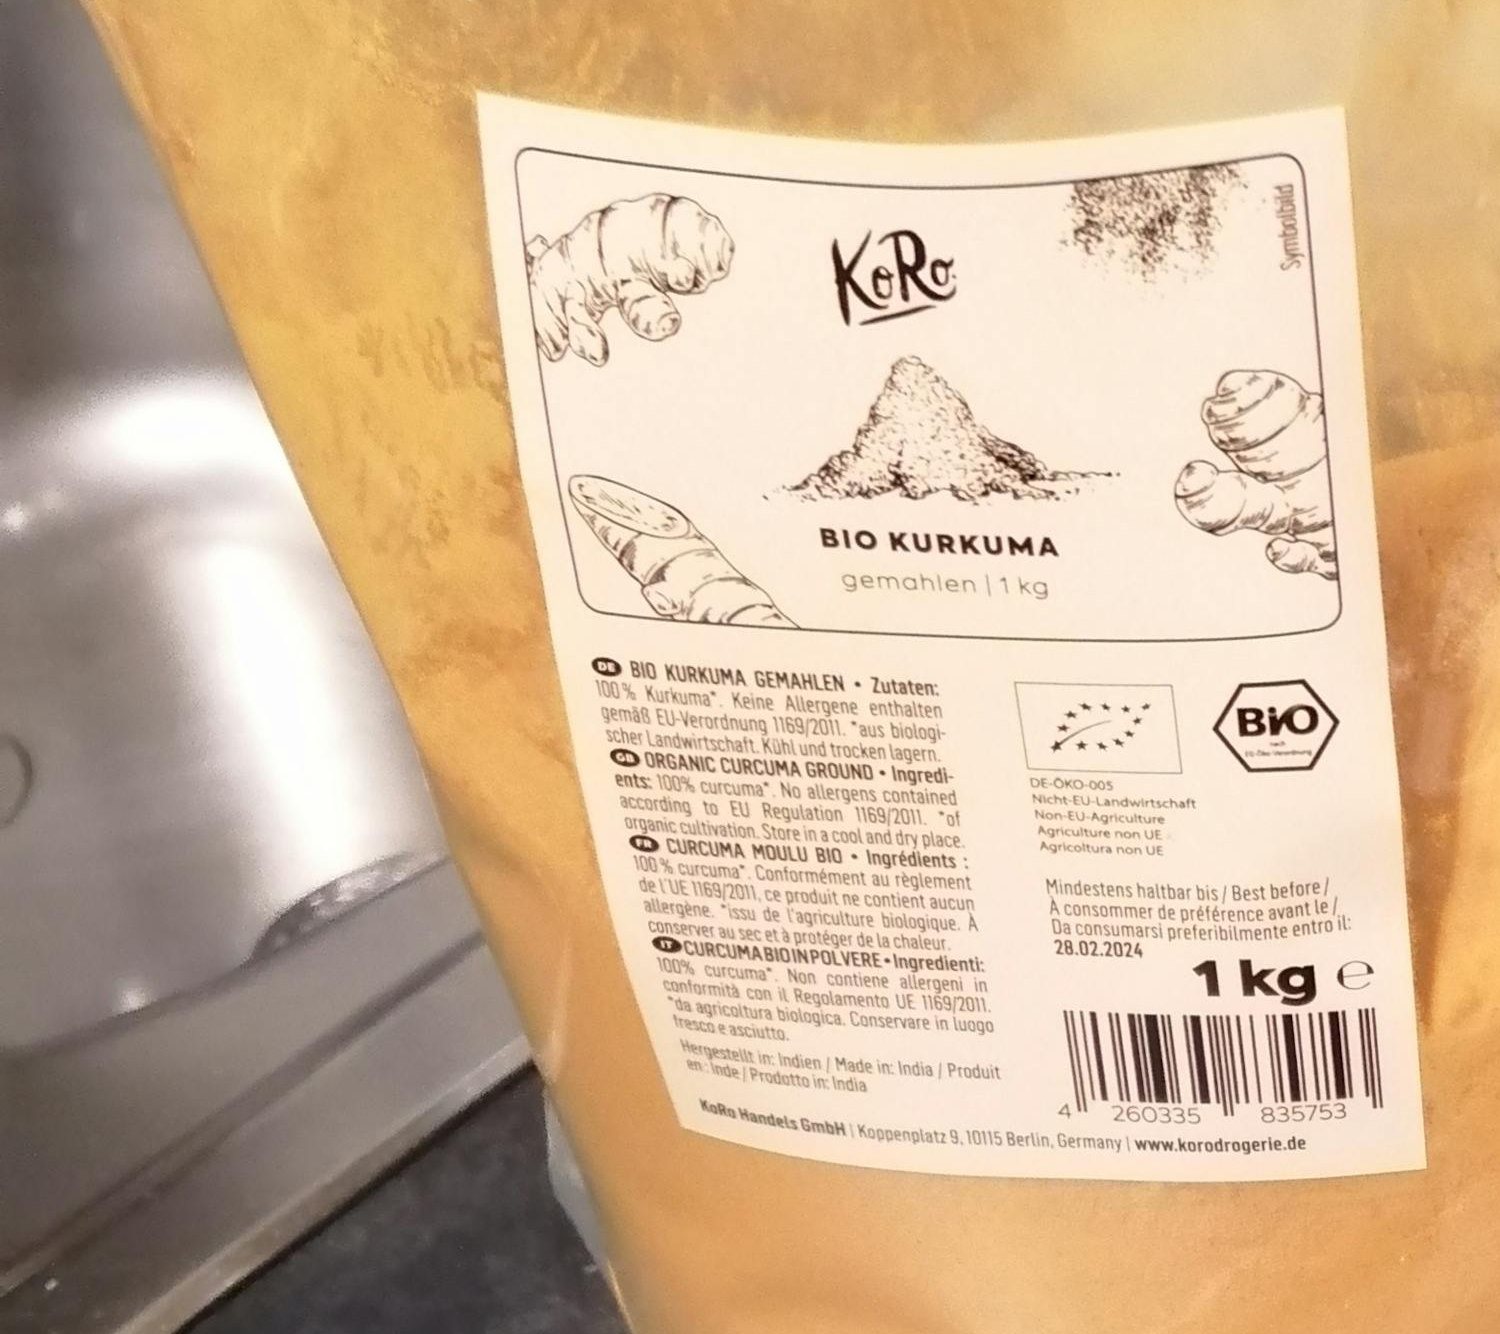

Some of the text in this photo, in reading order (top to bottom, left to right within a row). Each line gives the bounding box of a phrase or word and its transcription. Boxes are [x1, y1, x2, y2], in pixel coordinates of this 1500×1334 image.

[1274, 184, 1305, 271] Symbolbild
[832, 229, 957, 327] KoRo
[819, 527, 1060, 557] BIO KURKUMA
[842, 573, 1049, 600] gemahlen 1 kg
[630, 661, 656, 679] BIO
[665, 663, 747, 686] KURKUMA
[754, 670, 845, 692] GEMAHLEN
[871, 676, 939, 696] Zutaten:
[732, 692, 773, 711] Keine
[786, 695, 858, 716] Allergene
[869, 700, 943, 718] enthalten
[601, 706, 650, 723] gemäß
[656, 708, 767, 735] EU-Verordnung
[772, 715, 846, 738] 1169/2011.
[891, 722, 946, 744] biologi-
[606, 729, 942, 764] scher Landwirtschaft. Kühl und trocken lagern.
[644, 752, 716, 772] ORGANIC
[719, 758, 802, 778] CURCUMA
[805, 762, 874, 780] GROUND
[891, 766, 954, 786] Ingredi-
[1030, 777, 1114, 791] DE-ÖKO-005
[615, 773, 652, 789] ents:
[657, 774, 695, 793] 100%
[781, 782, 801, 799] No
[807, 784, 877, 804] allergens
[882, 789, 957, 806] contained
[1032, 794, 1197, 810] Nicht-EU-Landwirtschaft
[619, 795, 692, 816] according
[703, 801, 718, 816] to
[730, 800, 749, 818] EU
[761, 801, 844, 823] Regulation
[855, 806, 927, 827] 1169/2011.
[1034, 810, 1165, 825] Non-EU-Agriculture
[625, 817, 965, 849] organic cultivation. Store in a cool and dry place.
[1038, 826, 1162, 840] Agriculture non UE
[1040, 841, 1164, 856] Agricoltura non UE
[666, 838, 745, 859] CURCUMA
[752, 844, 808, 862] MOULU
[815, 847, 843, 864] BIO
[866, 849, 957, 868] Ingrédients
[1046, 878, 1321, 901] Mindestens haltbar bis Best before
[1050, 896, 1328, 923] À consommer de préférence avant le
[1052, 915, 1351, 942] Da consumarsi preferibilmente entro il:
[684, 940, 761, 962] CURCUMA
[765, 946, 791, 963] BIO
[793, 949, 809, 964] IN
[810, 948, 882, 968] POLVERE
[894, 954, 985, 973] Ingredienti:
[1054, 939, 1143, 958] 28.02.2024
[657, 957, 695, 975] 100%
[787, 969, 816, 985] Non
[827, 971, 889, 989] contiene
[900, 975, 963, 994] allergeni
[975, 977, 988, 992] in
[1192, 959, 1317, 1007] 1 kg
[663, 979, 991, 1014] conformità con il Regolamento UE 1169/2011.
[673, 1014, 790, 1041] fresco e asciutto.
[696, 1002, 773, 1021] agricoltura
[777, 1008, 845, 1027] biologica.
[850, 1011, 930, 1030] Conservare
[936, 1016, 949, 1031] in
[953, 1016, 994, 1036] luogo
[680, 1038, 1002, 1080] Hergestellt in: Indien Made in: India Produit
[699, 1098, 736, 1118] KoRo
[738, 1107, 798, 1131] Handels
[800, 1118, 847, 1136] GmbH
[857, 1124, 947, 1145] Koppenplatz
[966, 1130, 1002, 1146] 10115
[1006, 1131, 1054, 1149] Berlin,
[1057, 1133, 1121, 1153] Germany
[1135, 1136, 1307, 1155] www.korodrogerie.de
[1058, 1102, 1347, 1124] 4 260335 835753
